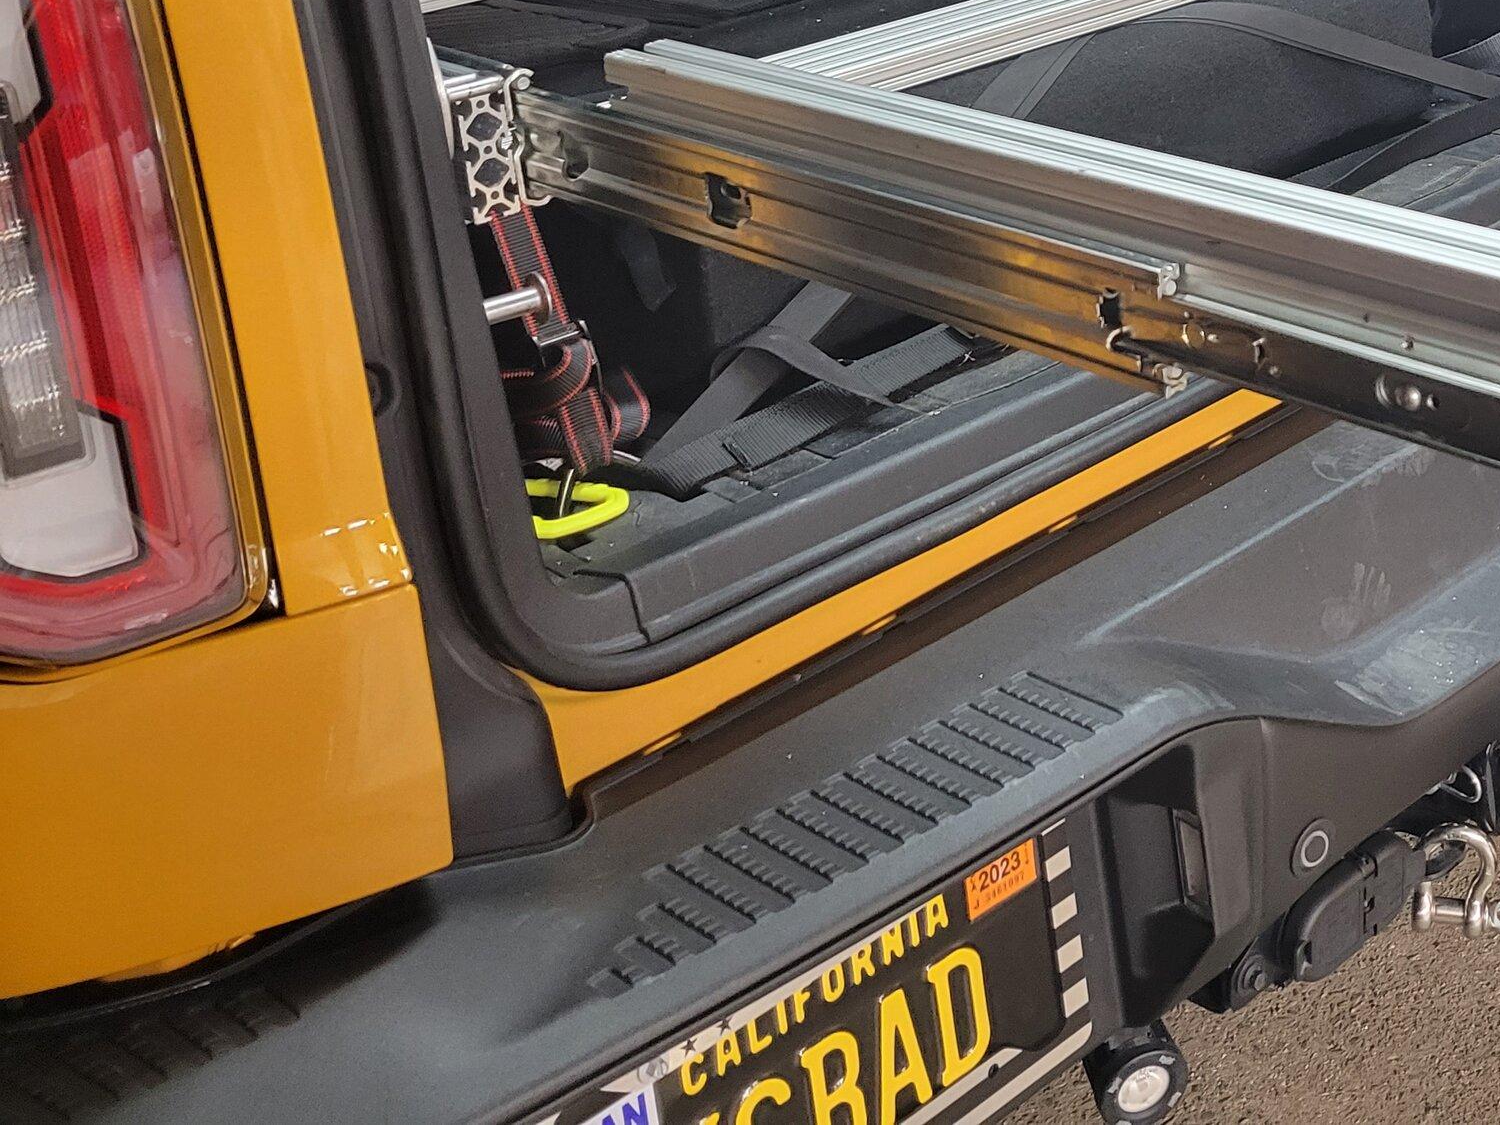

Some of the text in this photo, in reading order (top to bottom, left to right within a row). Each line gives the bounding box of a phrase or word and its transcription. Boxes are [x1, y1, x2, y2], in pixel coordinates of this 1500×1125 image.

[979, 851, 1021, 892] 2023
[680, 894, 949, 1096] CALIFORNIA
[700, 947, 991, 1125] BAD
